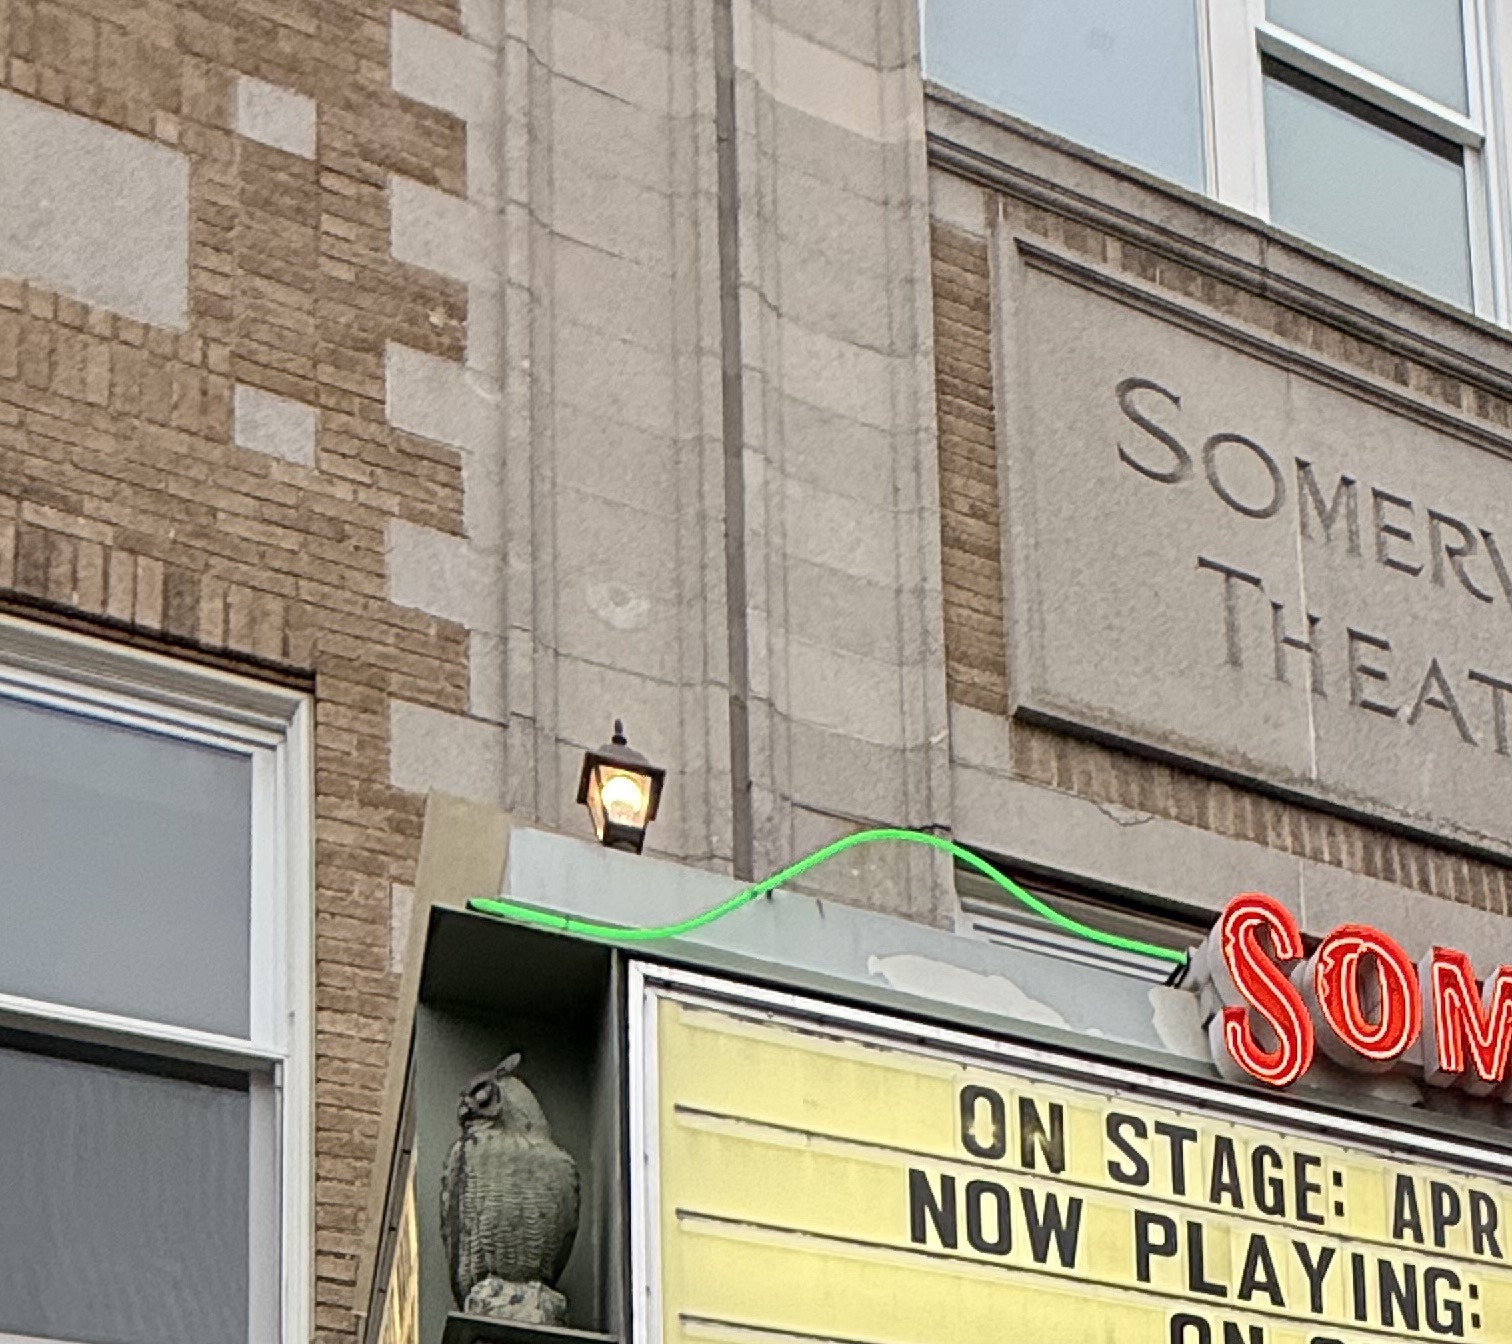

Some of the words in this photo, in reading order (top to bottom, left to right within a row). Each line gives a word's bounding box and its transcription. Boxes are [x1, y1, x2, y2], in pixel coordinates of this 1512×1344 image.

[908, 1167, 1084, 1269] NOW
[1134, 1210, 1481, 1338] PLAYING:
[959, 1084, 1066, 1175] ON
[1105, 1111, 1345, 1226] STAGE:
[1392, 1172, 1504, 1260] APR
